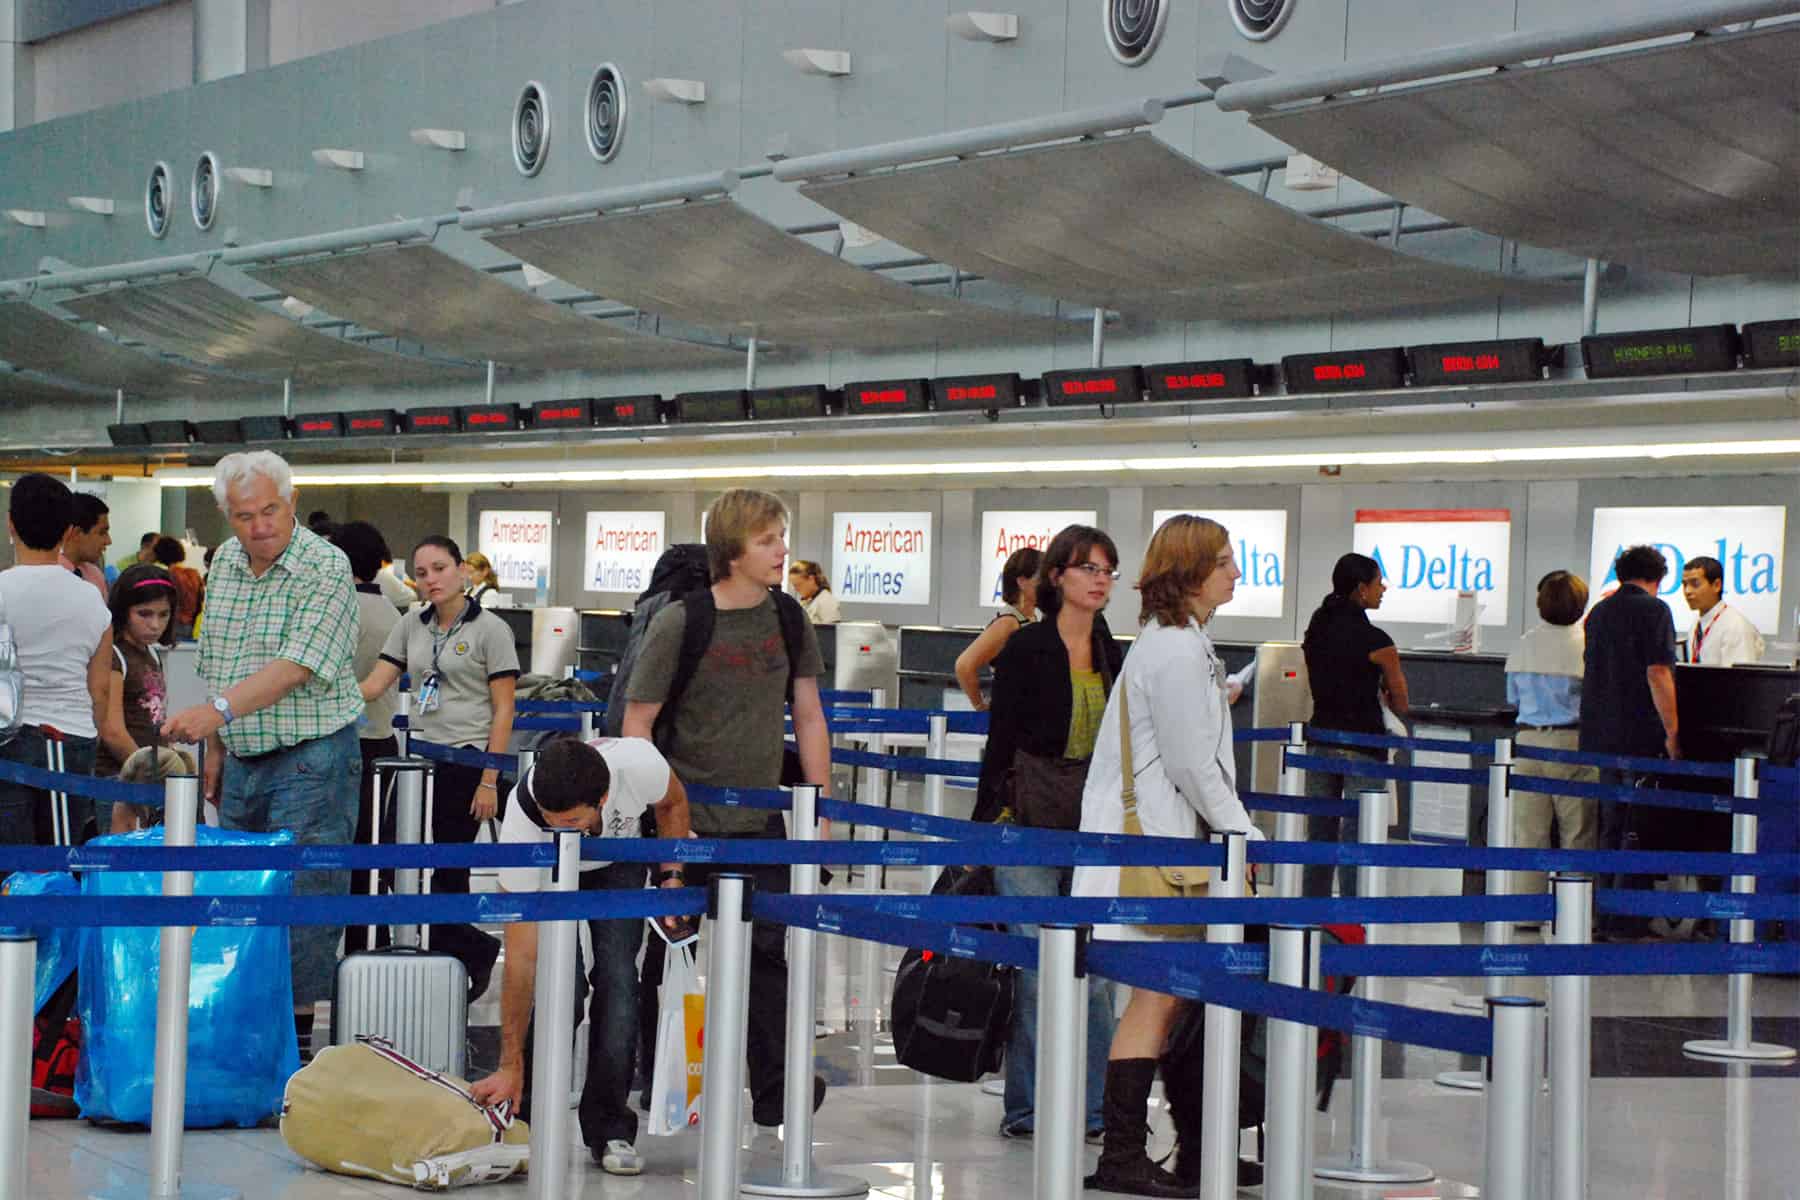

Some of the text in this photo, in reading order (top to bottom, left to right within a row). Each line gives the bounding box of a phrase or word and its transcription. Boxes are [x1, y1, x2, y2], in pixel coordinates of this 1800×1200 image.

[491, 517, 547, 543] American
[594, 522, 657, 551] American
[843, 521, 924, 553] American
[995, 527, 1057, 558] Ameri
[593, 560, 641, 589] Airlines
[1236, 539, 1284, 587] lta
[1400, 544, 1495, 592] Delta
[1651, 536, 1778, 596] Dlta
[842, 563, 904, 596] Airlines
